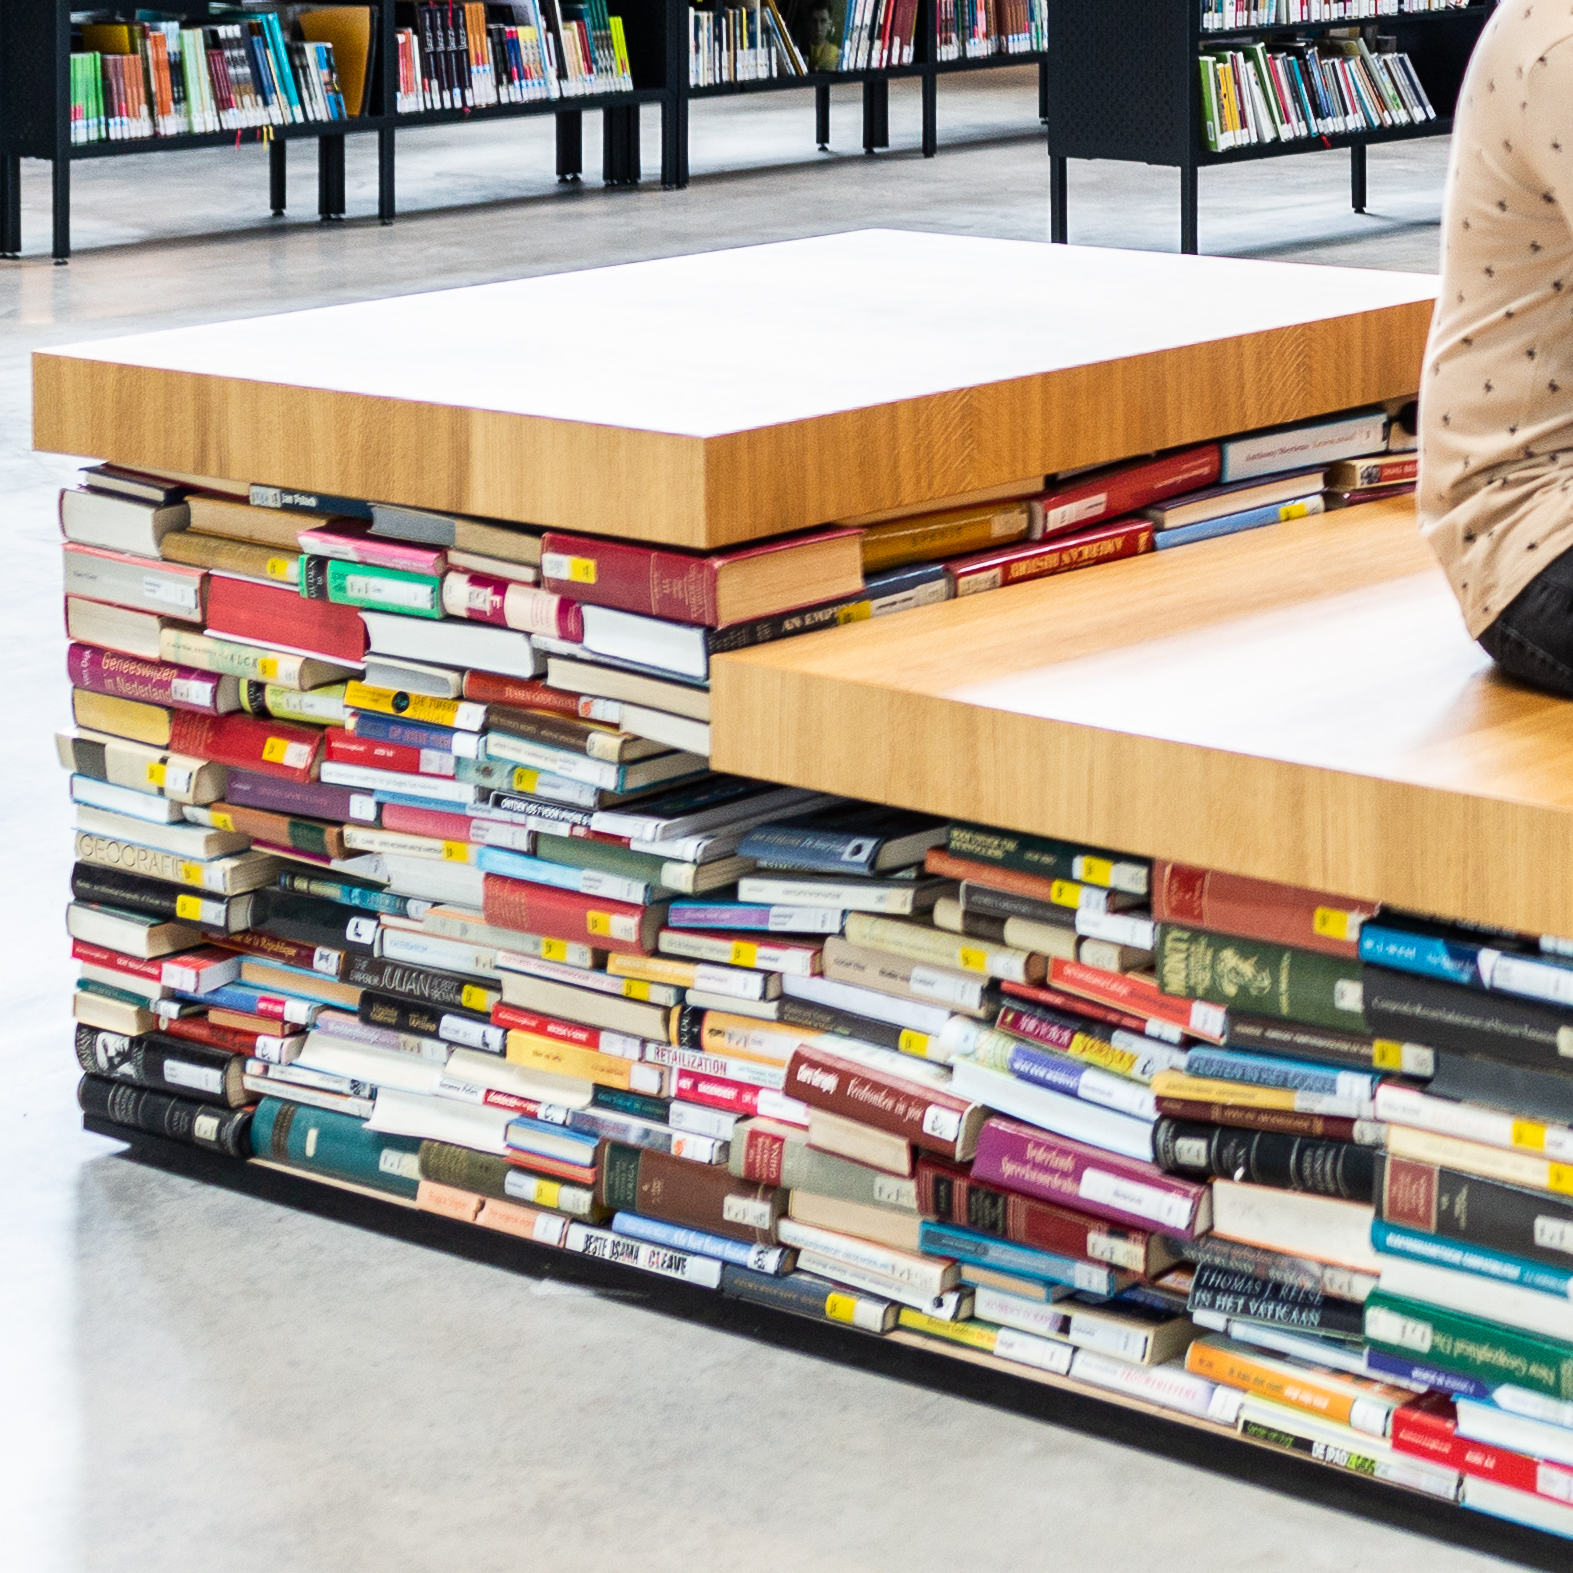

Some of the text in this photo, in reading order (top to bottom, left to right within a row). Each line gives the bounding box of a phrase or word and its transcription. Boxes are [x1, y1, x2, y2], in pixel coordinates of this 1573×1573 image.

[101, 651, 178, 684] Geneeswijzen
[115, 677, 171, 703] Nederland
[379, 969, 432, 1001] JULIAN
[654, 1045, 728, 1076] RETAILIZATION
[583, 1232, 607, 1258] BESTE
[608, 1238, 639, 1265] OSAMA
[1200, 1266, 1262, 1295] THOMAS
[1276, 1283, 1324, 1306] REESE
[1195, 1290, 1322, 1327] IN HET VATICAAN
